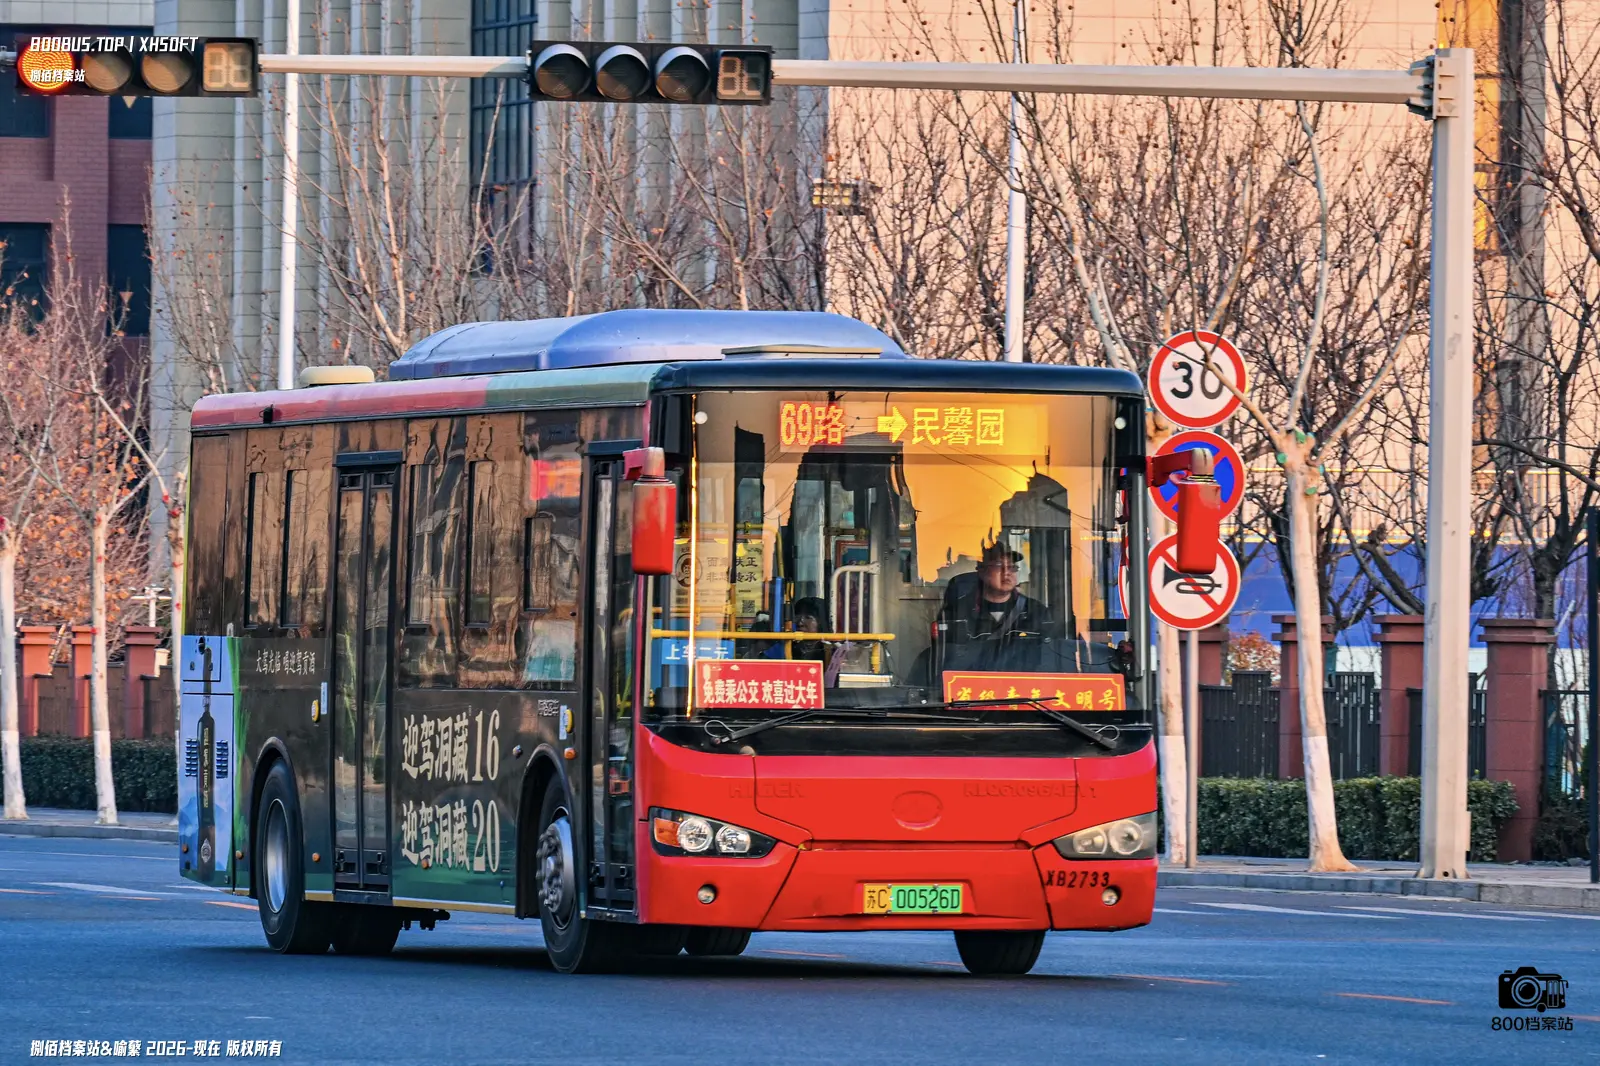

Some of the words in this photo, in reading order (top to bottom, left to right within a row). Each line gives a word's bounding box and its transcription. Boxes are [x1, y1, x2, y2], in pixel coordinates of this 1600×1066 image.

[1170, 361, 1224, 400] 30
[780, 403, 846, 446] 69路
[911, 406, 1005, 446] 民馨园
[702, 679, 760, 705] 免费乘公交
[761, 679, 819, 705] 欢喜过大年
[1045, 870, 1110, 888] XB2733
